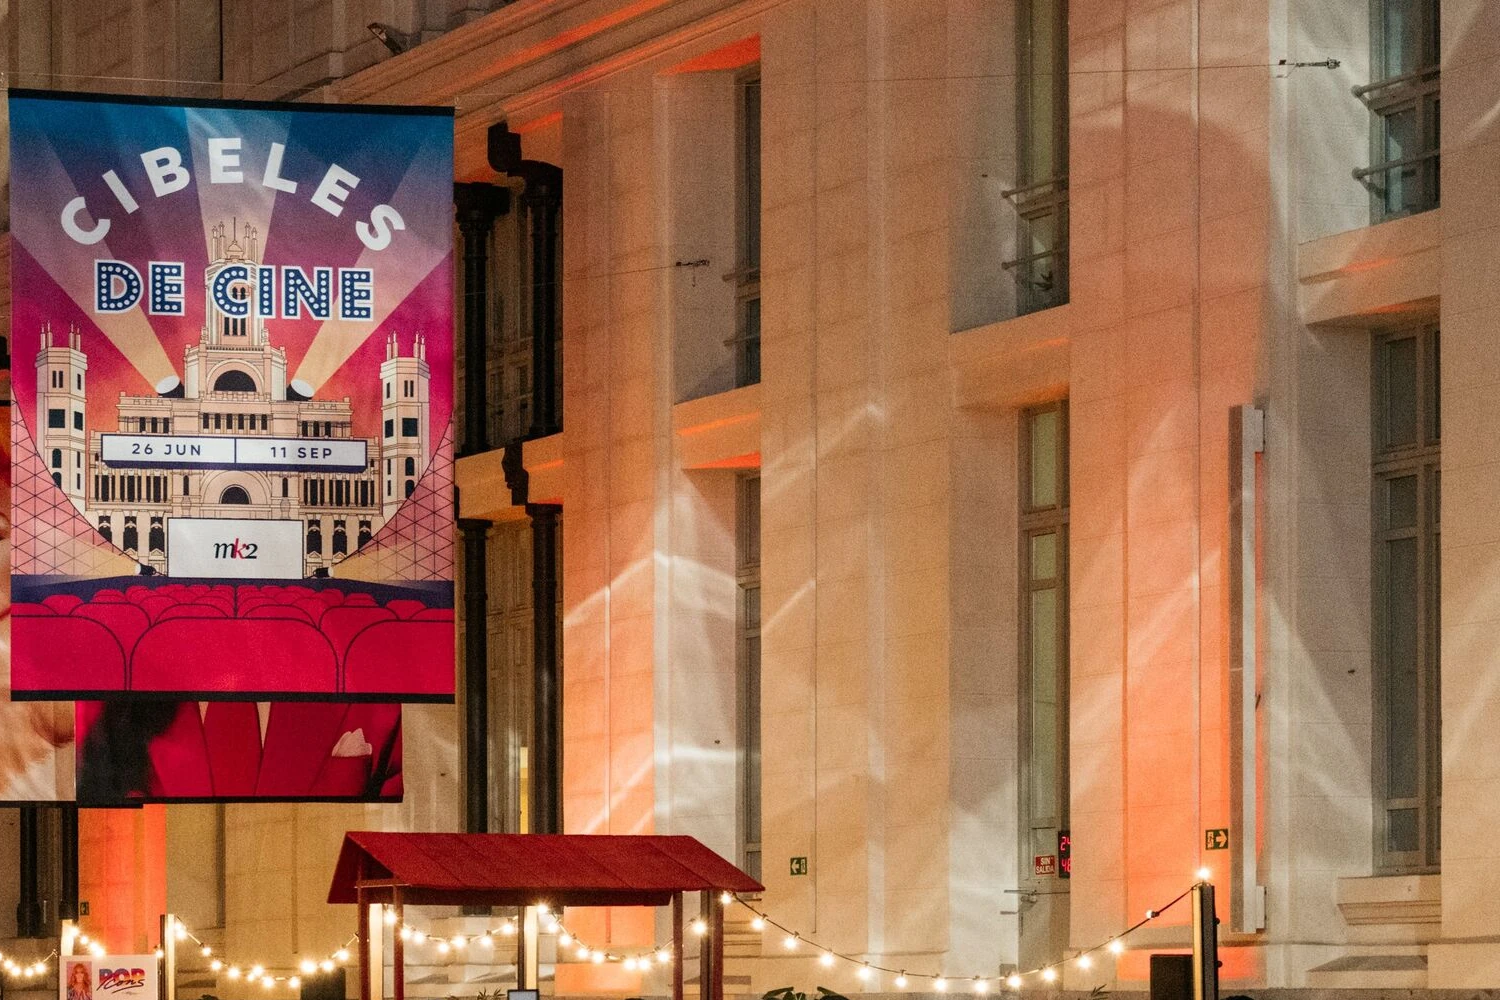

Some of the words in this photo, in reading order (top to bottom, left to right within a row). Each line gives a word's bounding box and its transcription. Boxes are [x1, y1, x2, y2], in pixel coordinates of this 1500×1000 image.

[61, 137, 405, 251] CIBELES
[94, 259, 185, 316] DE
[211, 264, 374, 322] CINE
[132, 443, 153, 455] 26
[164, 444, 201, 456] JUN
[270, 447, 287, 459] 11
[298, 448, 332, 459] SEP
[214, 538, 258, 560] mk2
[99, 968, 145, 986] POP
